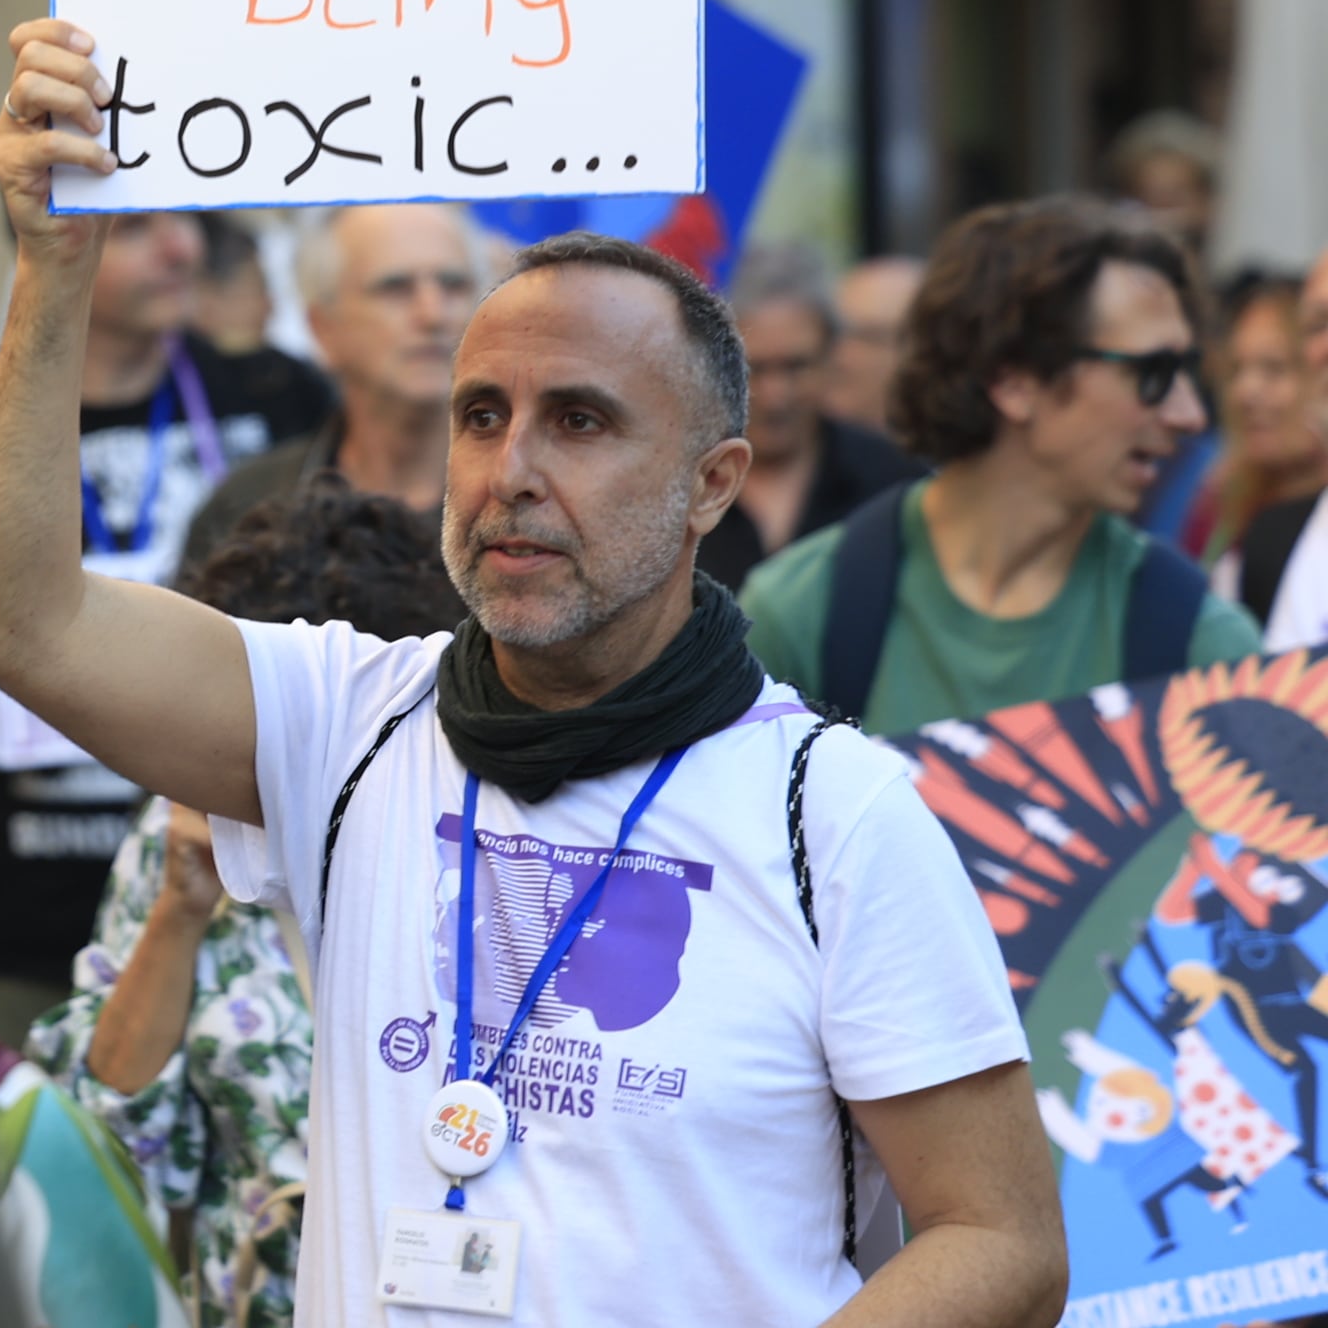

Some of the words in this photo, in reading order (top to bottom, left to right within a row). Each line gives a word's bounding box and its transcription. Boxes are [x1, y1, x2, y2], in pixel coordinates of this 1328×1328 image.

[101, 56, 639, 186] toxic...
[552, 846, 594, 866] hace
[532, 1034, 603, 1061] CONTRA
[449, 1103, 480, 1129] 21
[458, 1124, 492, 1157] 26
